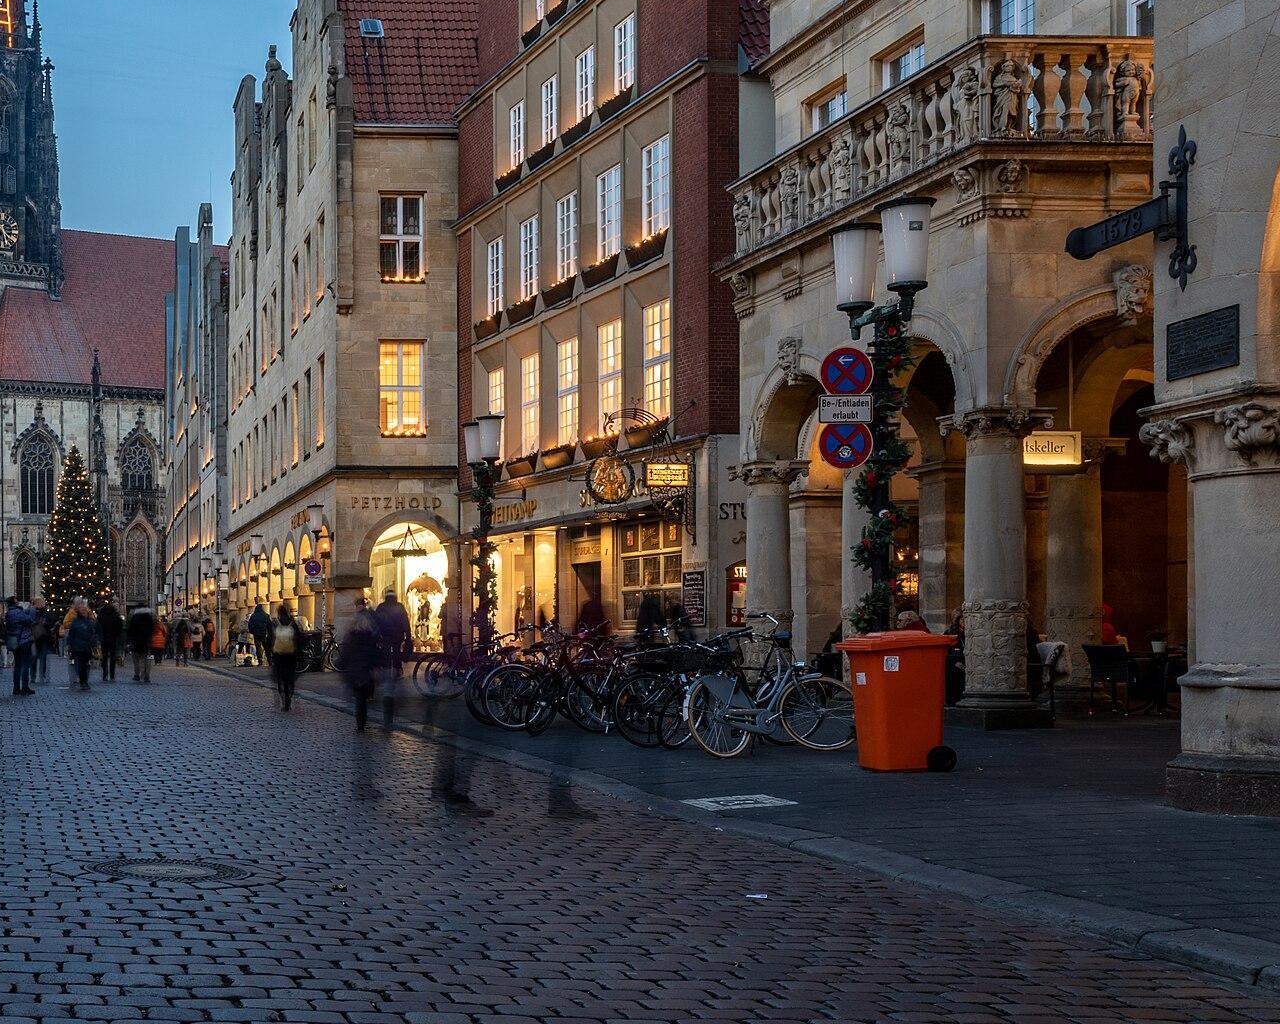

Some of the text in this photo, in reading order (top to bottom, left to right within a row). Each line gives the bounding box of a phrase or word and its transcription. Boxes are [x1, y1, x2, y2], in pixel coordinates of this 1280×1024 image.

[822, 398, 869, 408] Be-/Entladen
[832, 411, 859, 419] erlaubt
[1025, 440, 1065, 453] tskeller
[351, 496, 442, 510] PETZHOLD
